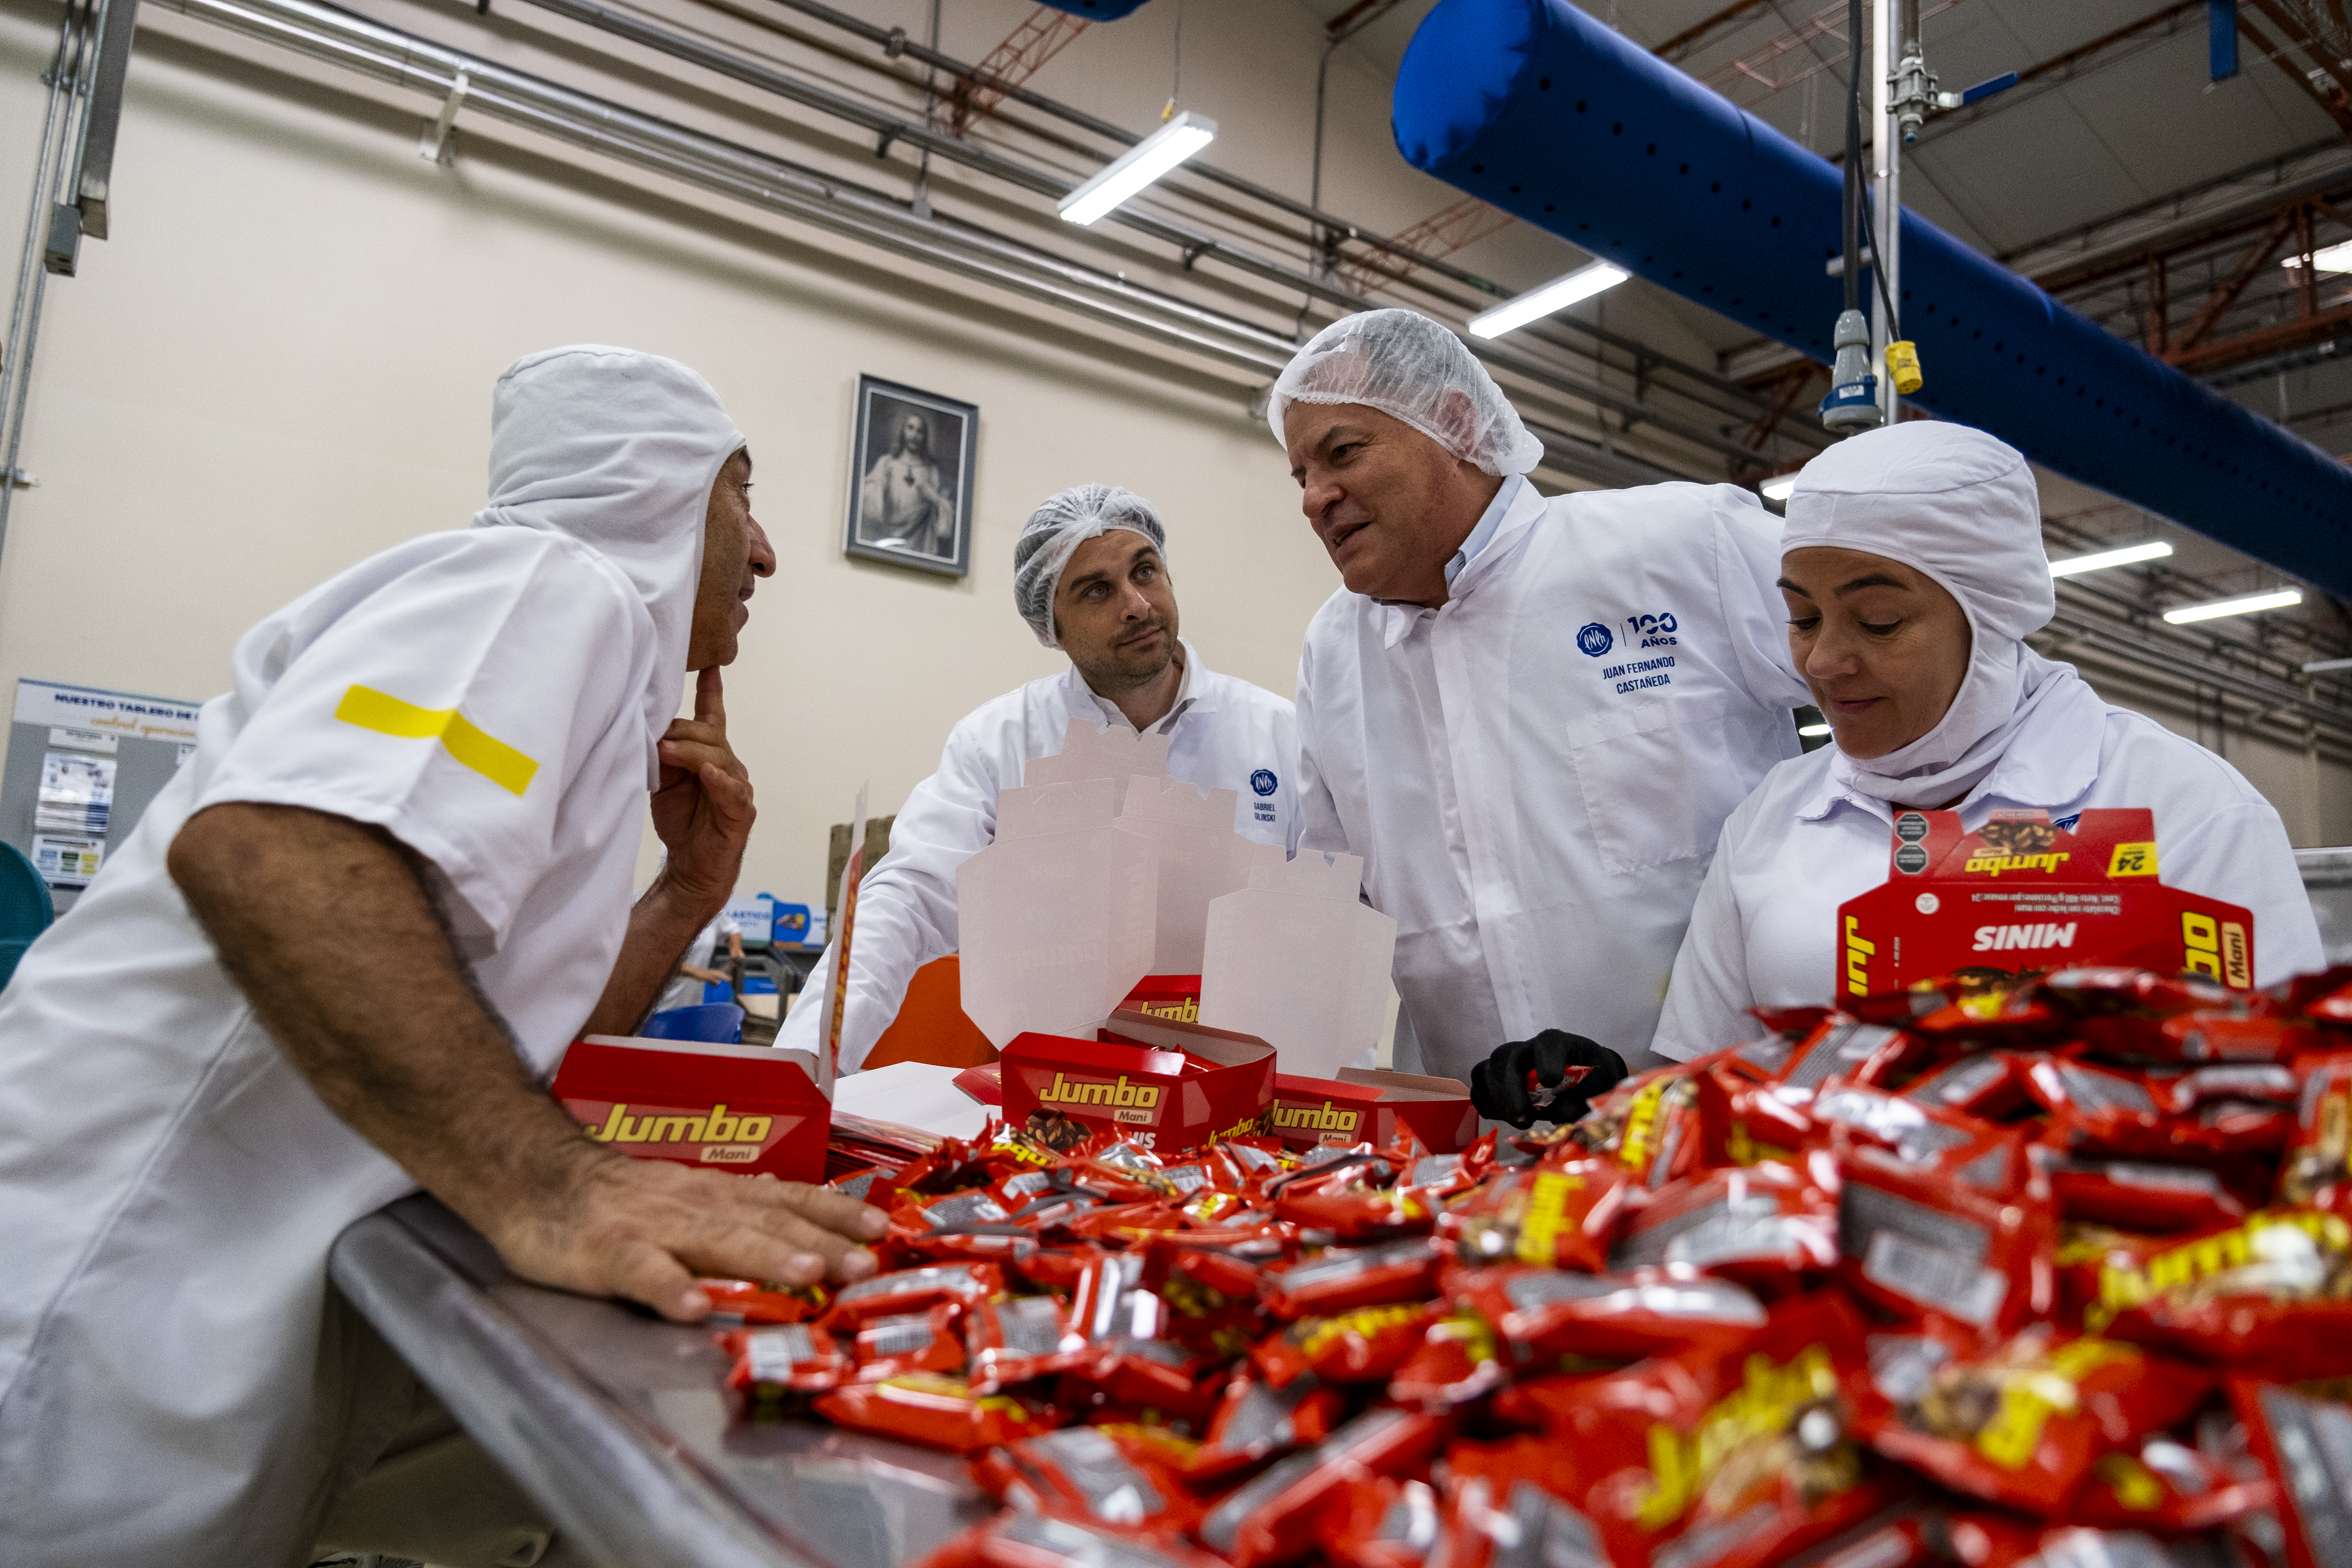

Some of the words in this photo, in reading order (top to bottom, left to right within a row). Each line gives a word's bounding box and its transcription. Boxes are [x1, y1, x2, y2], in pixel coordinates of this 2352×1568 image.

[1627, 612, 1678, 635] 100
[1641, 636, 1677, 649] AÑOS
[1603, 665, 1625, 680] JUAN
[1626, 656, 1675, 674] FERNANDO
[1616, 674, 1671, 694] CASTAÑEDA
[55, 694, 115, 709] NUESTRO
[119, 701, 174, 718] TABLERO
[176, 710, 191, 719] DE
[1964, 852, 2070, 877] Jumbo
[2117, 857, 2145, 872] 24
[1971, 922, 2078, 952] MINIS
[1038, 1072, 1160, 1108] Jumbo
[584, 1102, 773, 1142] Jumbo
